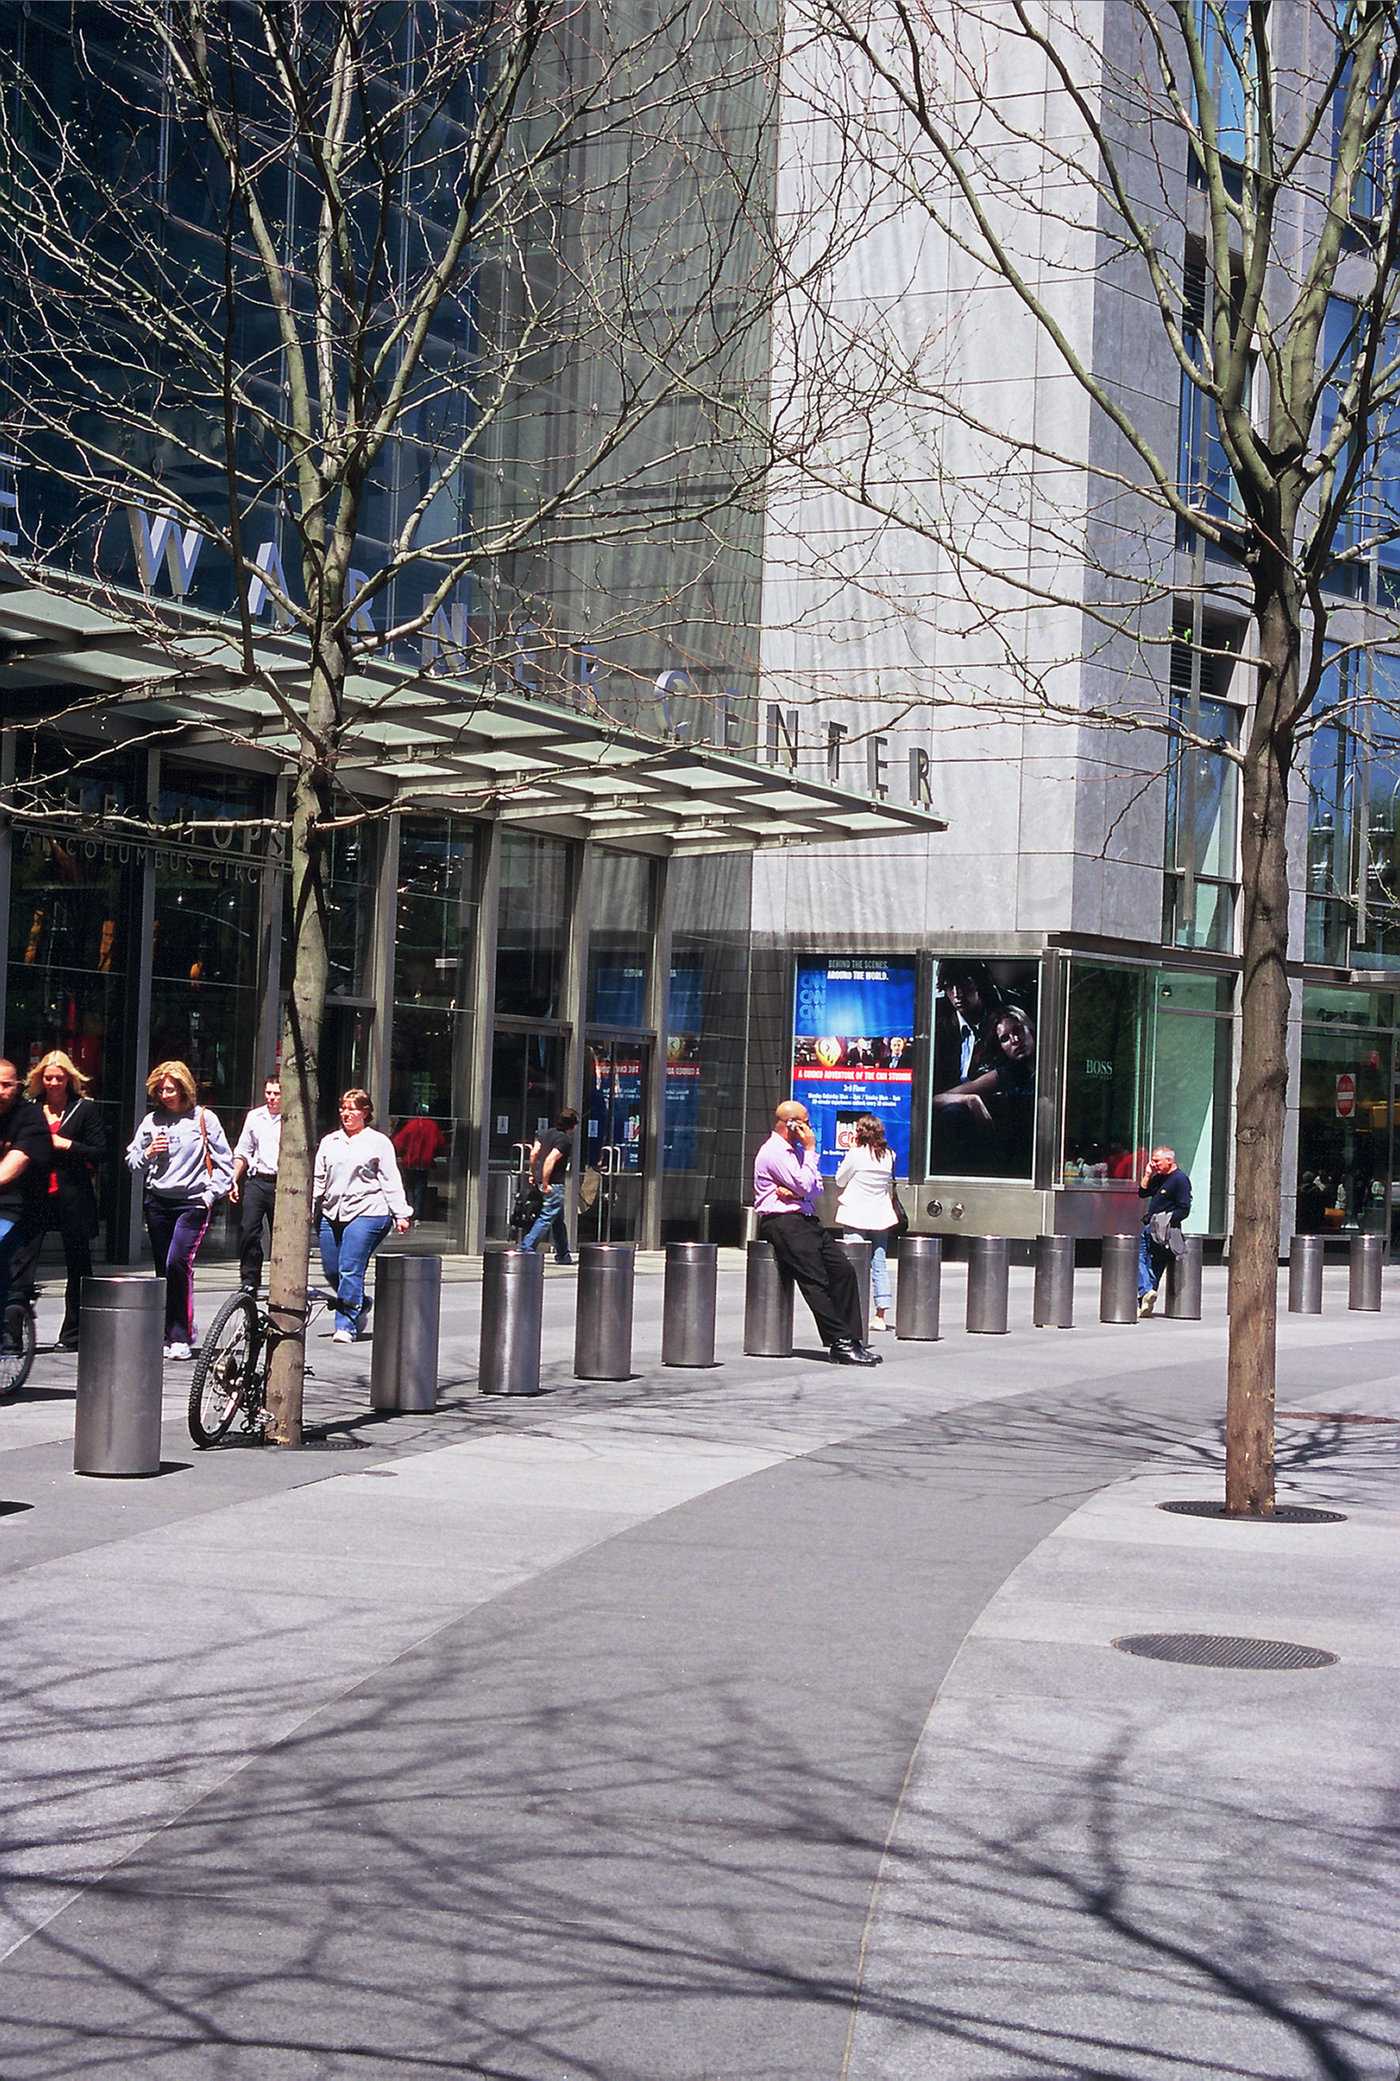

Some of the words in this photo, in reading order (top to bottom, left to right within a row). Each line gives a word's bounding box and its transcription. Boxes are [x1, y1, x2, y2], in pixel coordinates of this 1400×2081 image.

[654, 670, 934, 808] CENTER
[65, 837, 194, 874] COLUMBUS
[852, 970, 865, 980] THE
[1086, 1059, 1112, 1075] BOSS
